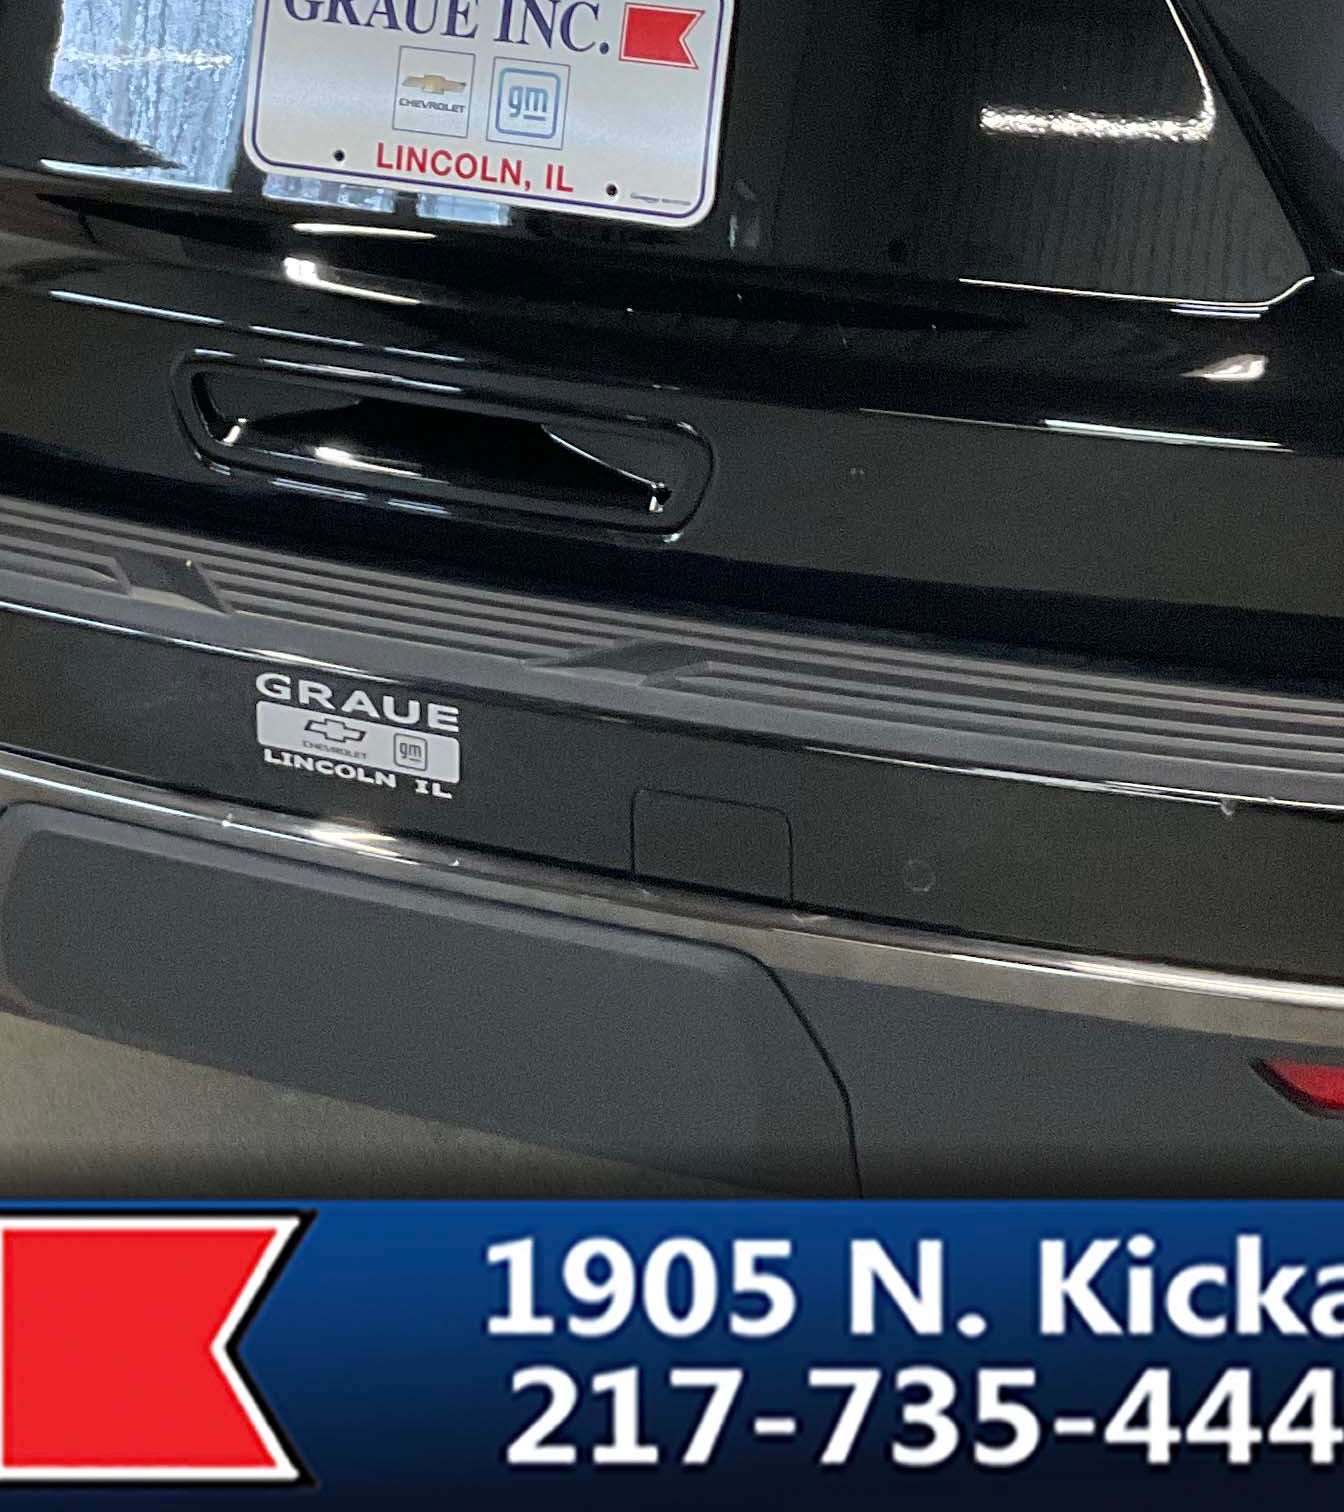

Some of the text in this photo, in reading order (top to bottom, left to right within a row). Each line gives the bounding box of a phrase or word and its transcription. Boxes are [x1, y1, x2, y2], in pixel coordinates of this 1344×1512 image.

[398, 97, 466, 114] CHEVROLET
[376, 142, 575, 194] LINCOLN, IL
[255, 672, 460, 733] GRAUE
[263, 748, 453, 800] LINCOLN IL
